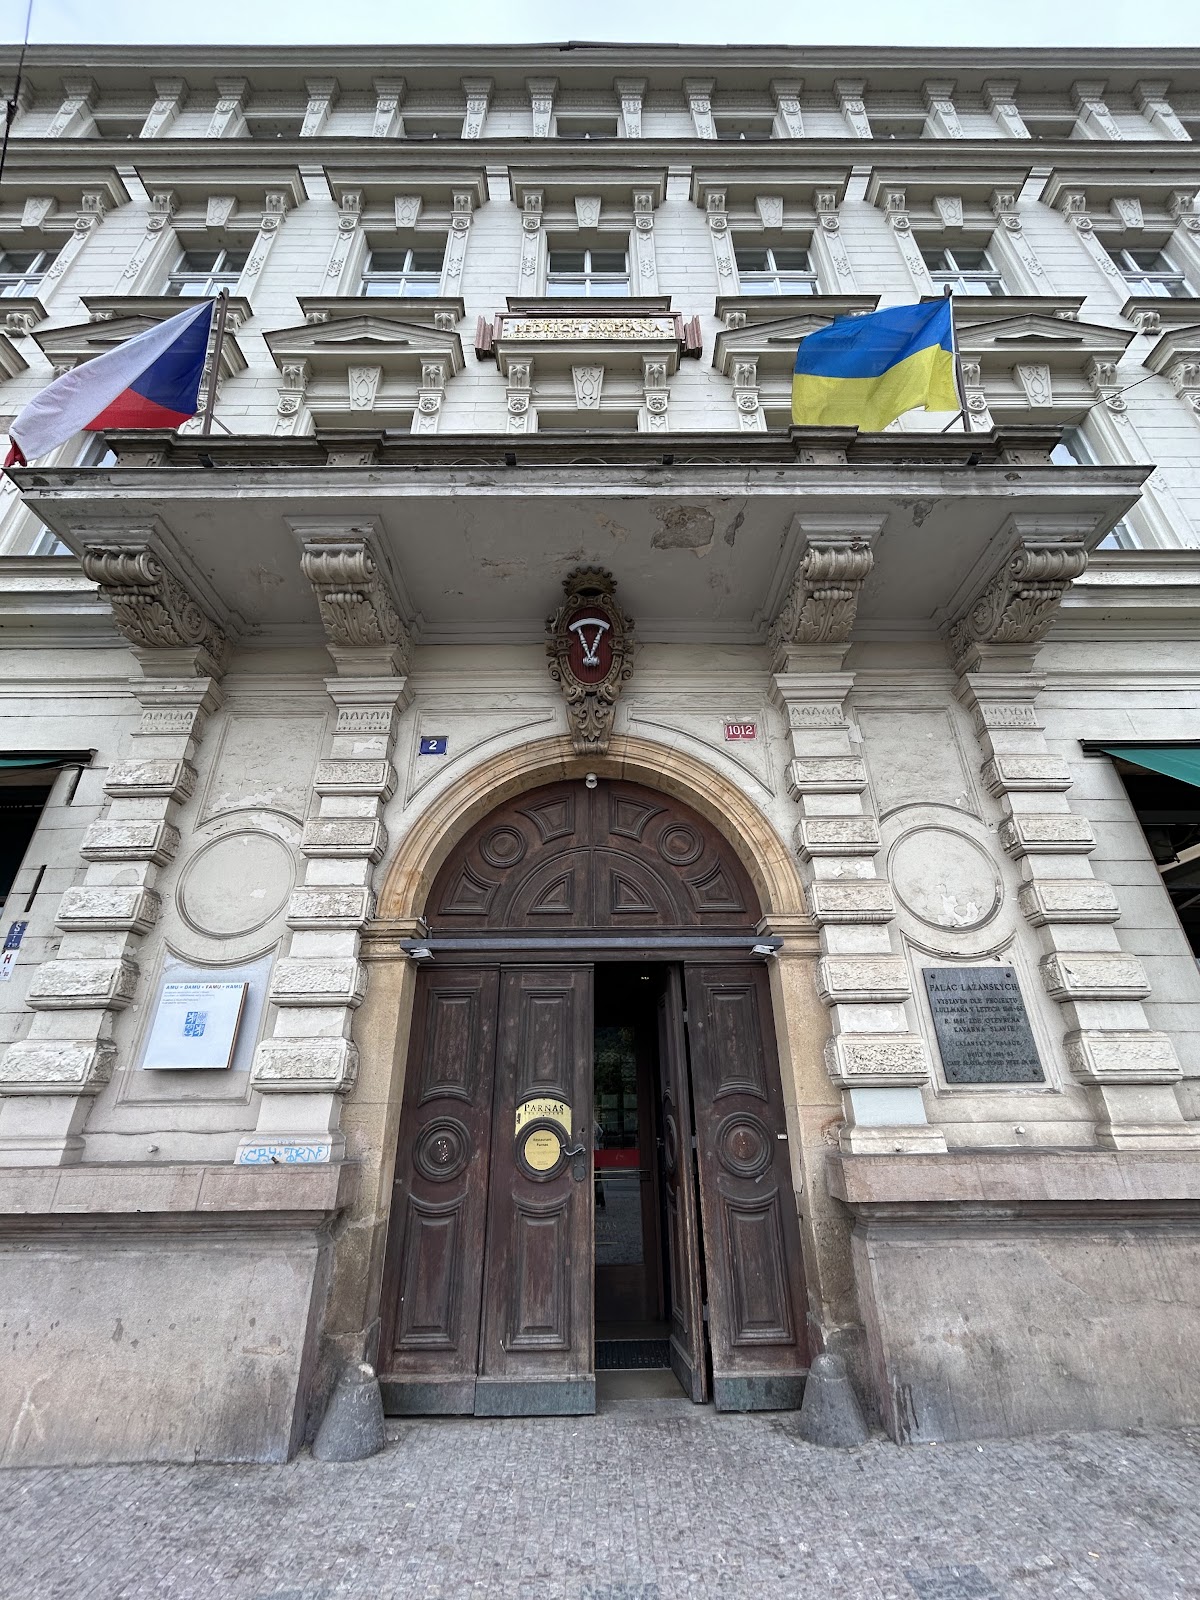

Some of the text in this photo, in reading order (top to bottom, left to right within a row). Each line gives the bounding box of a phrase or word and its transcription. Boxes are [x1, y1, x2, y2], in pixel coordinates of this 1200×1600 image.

[586, 324, 664, 333] SMETANA
[728, 725, 754, 735] 1012
[428, 739, 438, 750] 2
[4, 954, 12, 964] H
[930, 983, 957, 991] PALÁC
[524, 1104, 564, 1112] PARNAS
